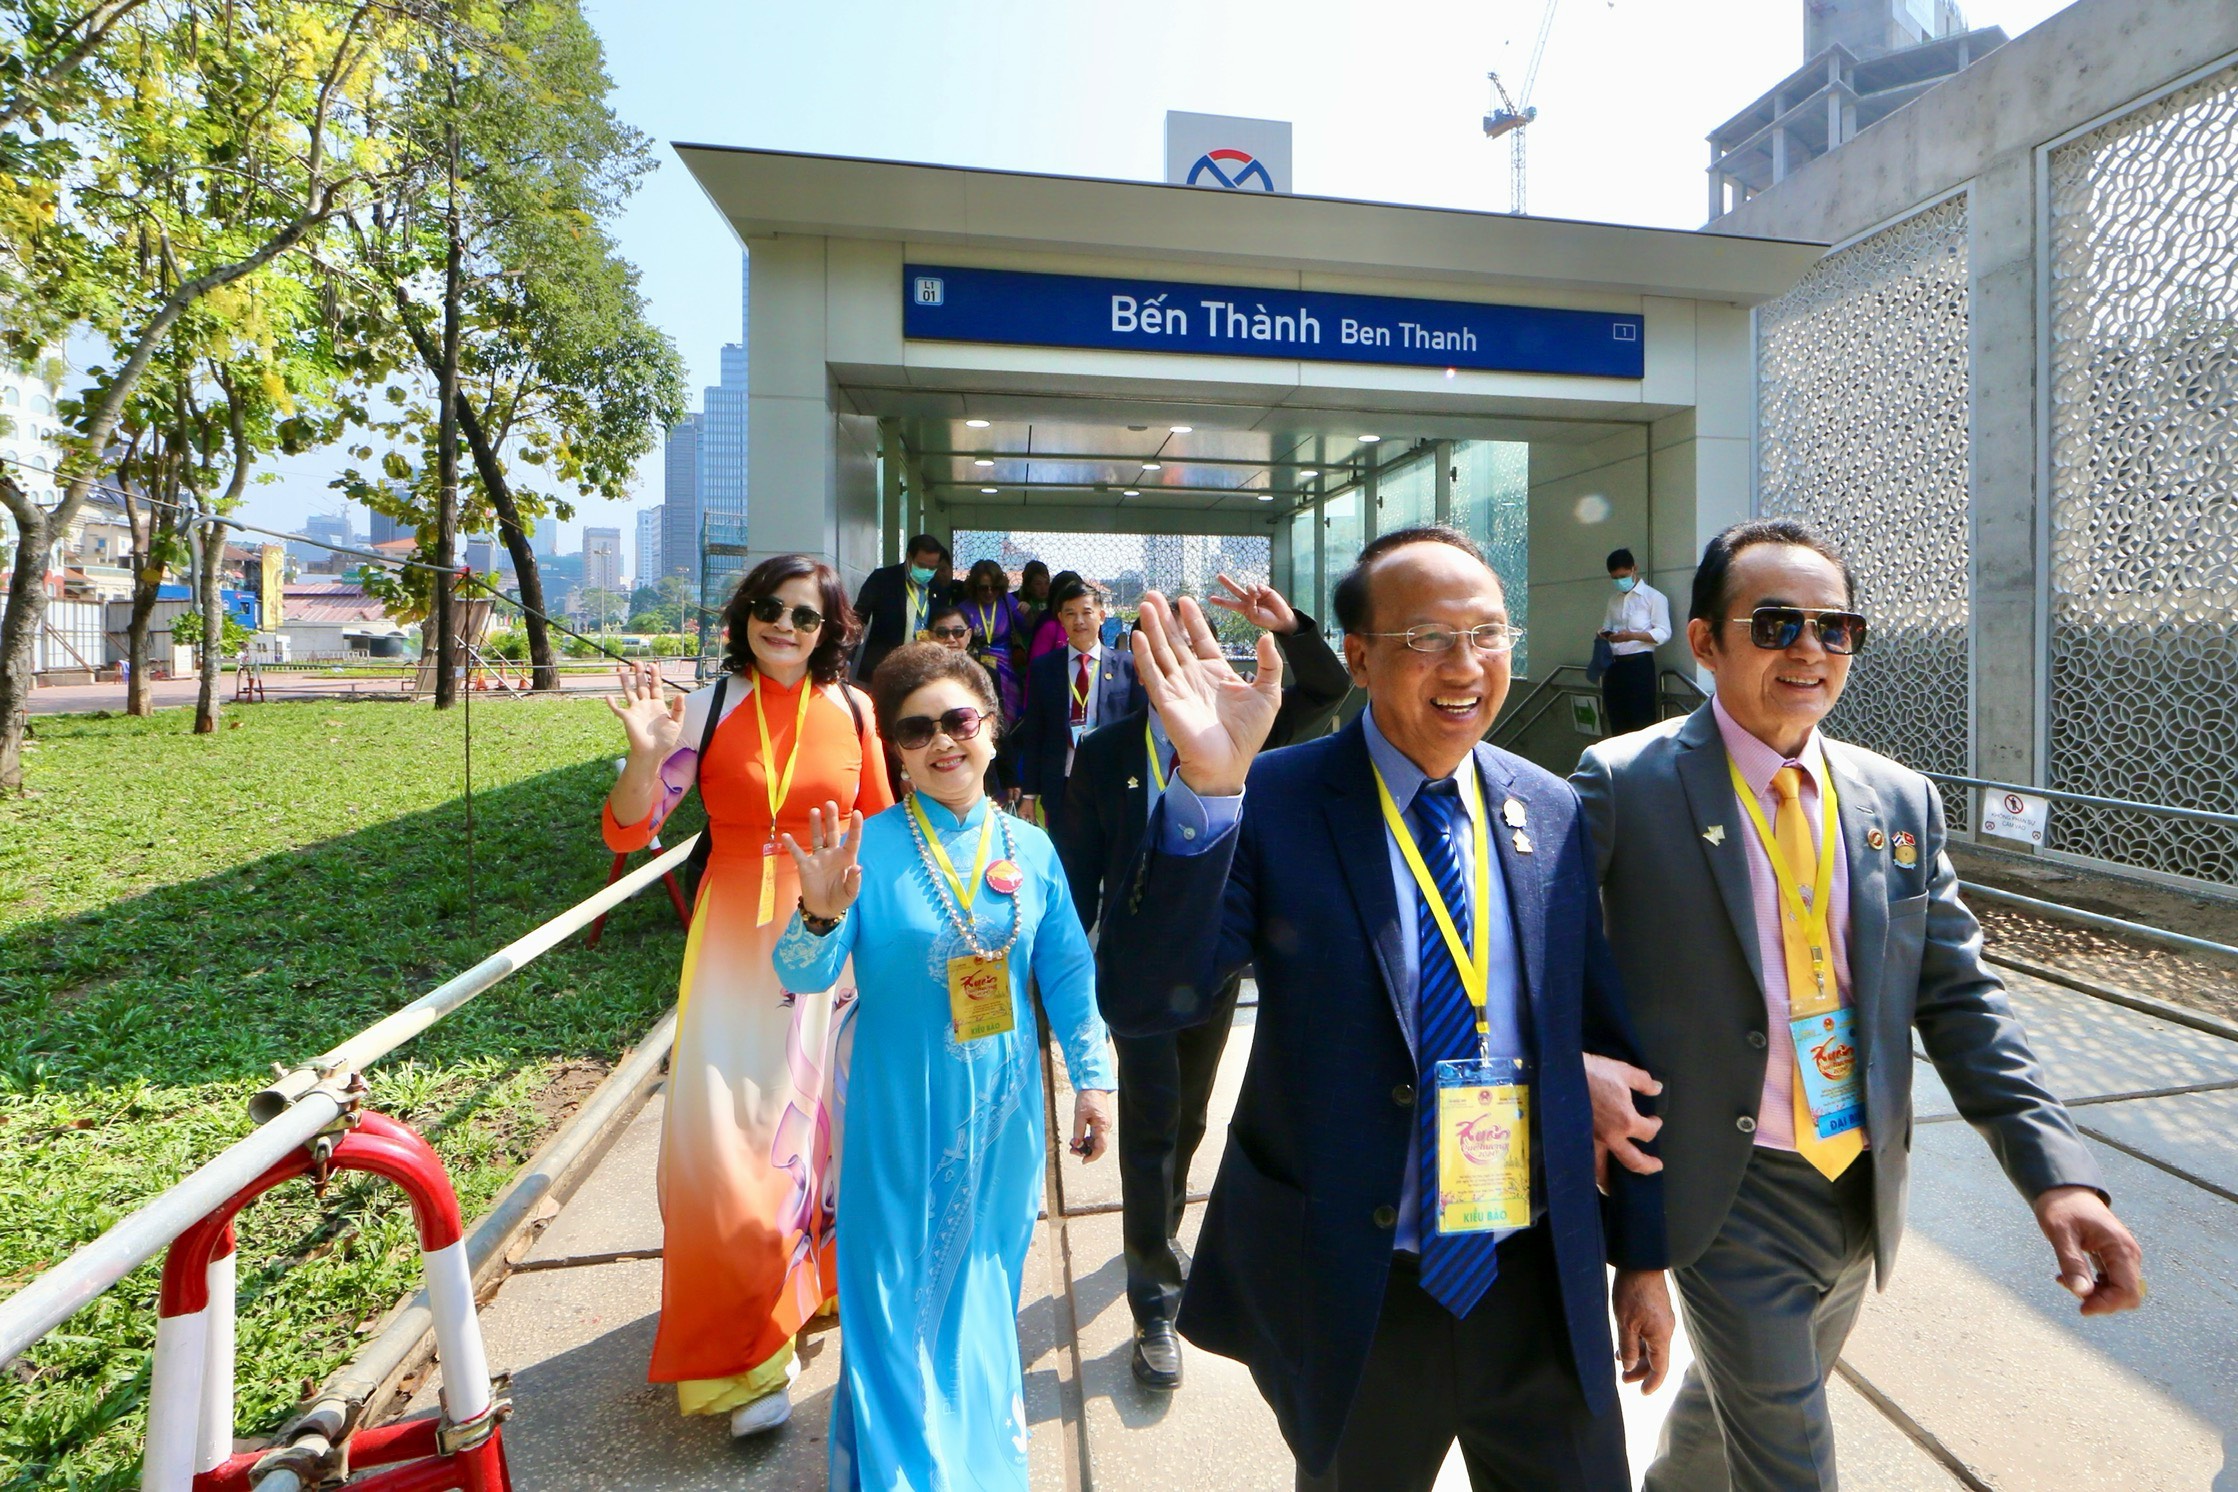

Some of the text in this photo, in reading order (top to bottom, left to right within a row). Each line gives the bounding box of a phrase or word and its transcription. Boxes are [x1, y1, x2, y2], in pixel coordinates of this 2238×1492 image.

[924, 281, 934, 290] L1
[922, 290, 936, 302] 01
[1111, 294, 1477, 352] Bến Thành Ben Thanh
[1623, 327, 1627, 337] 1
